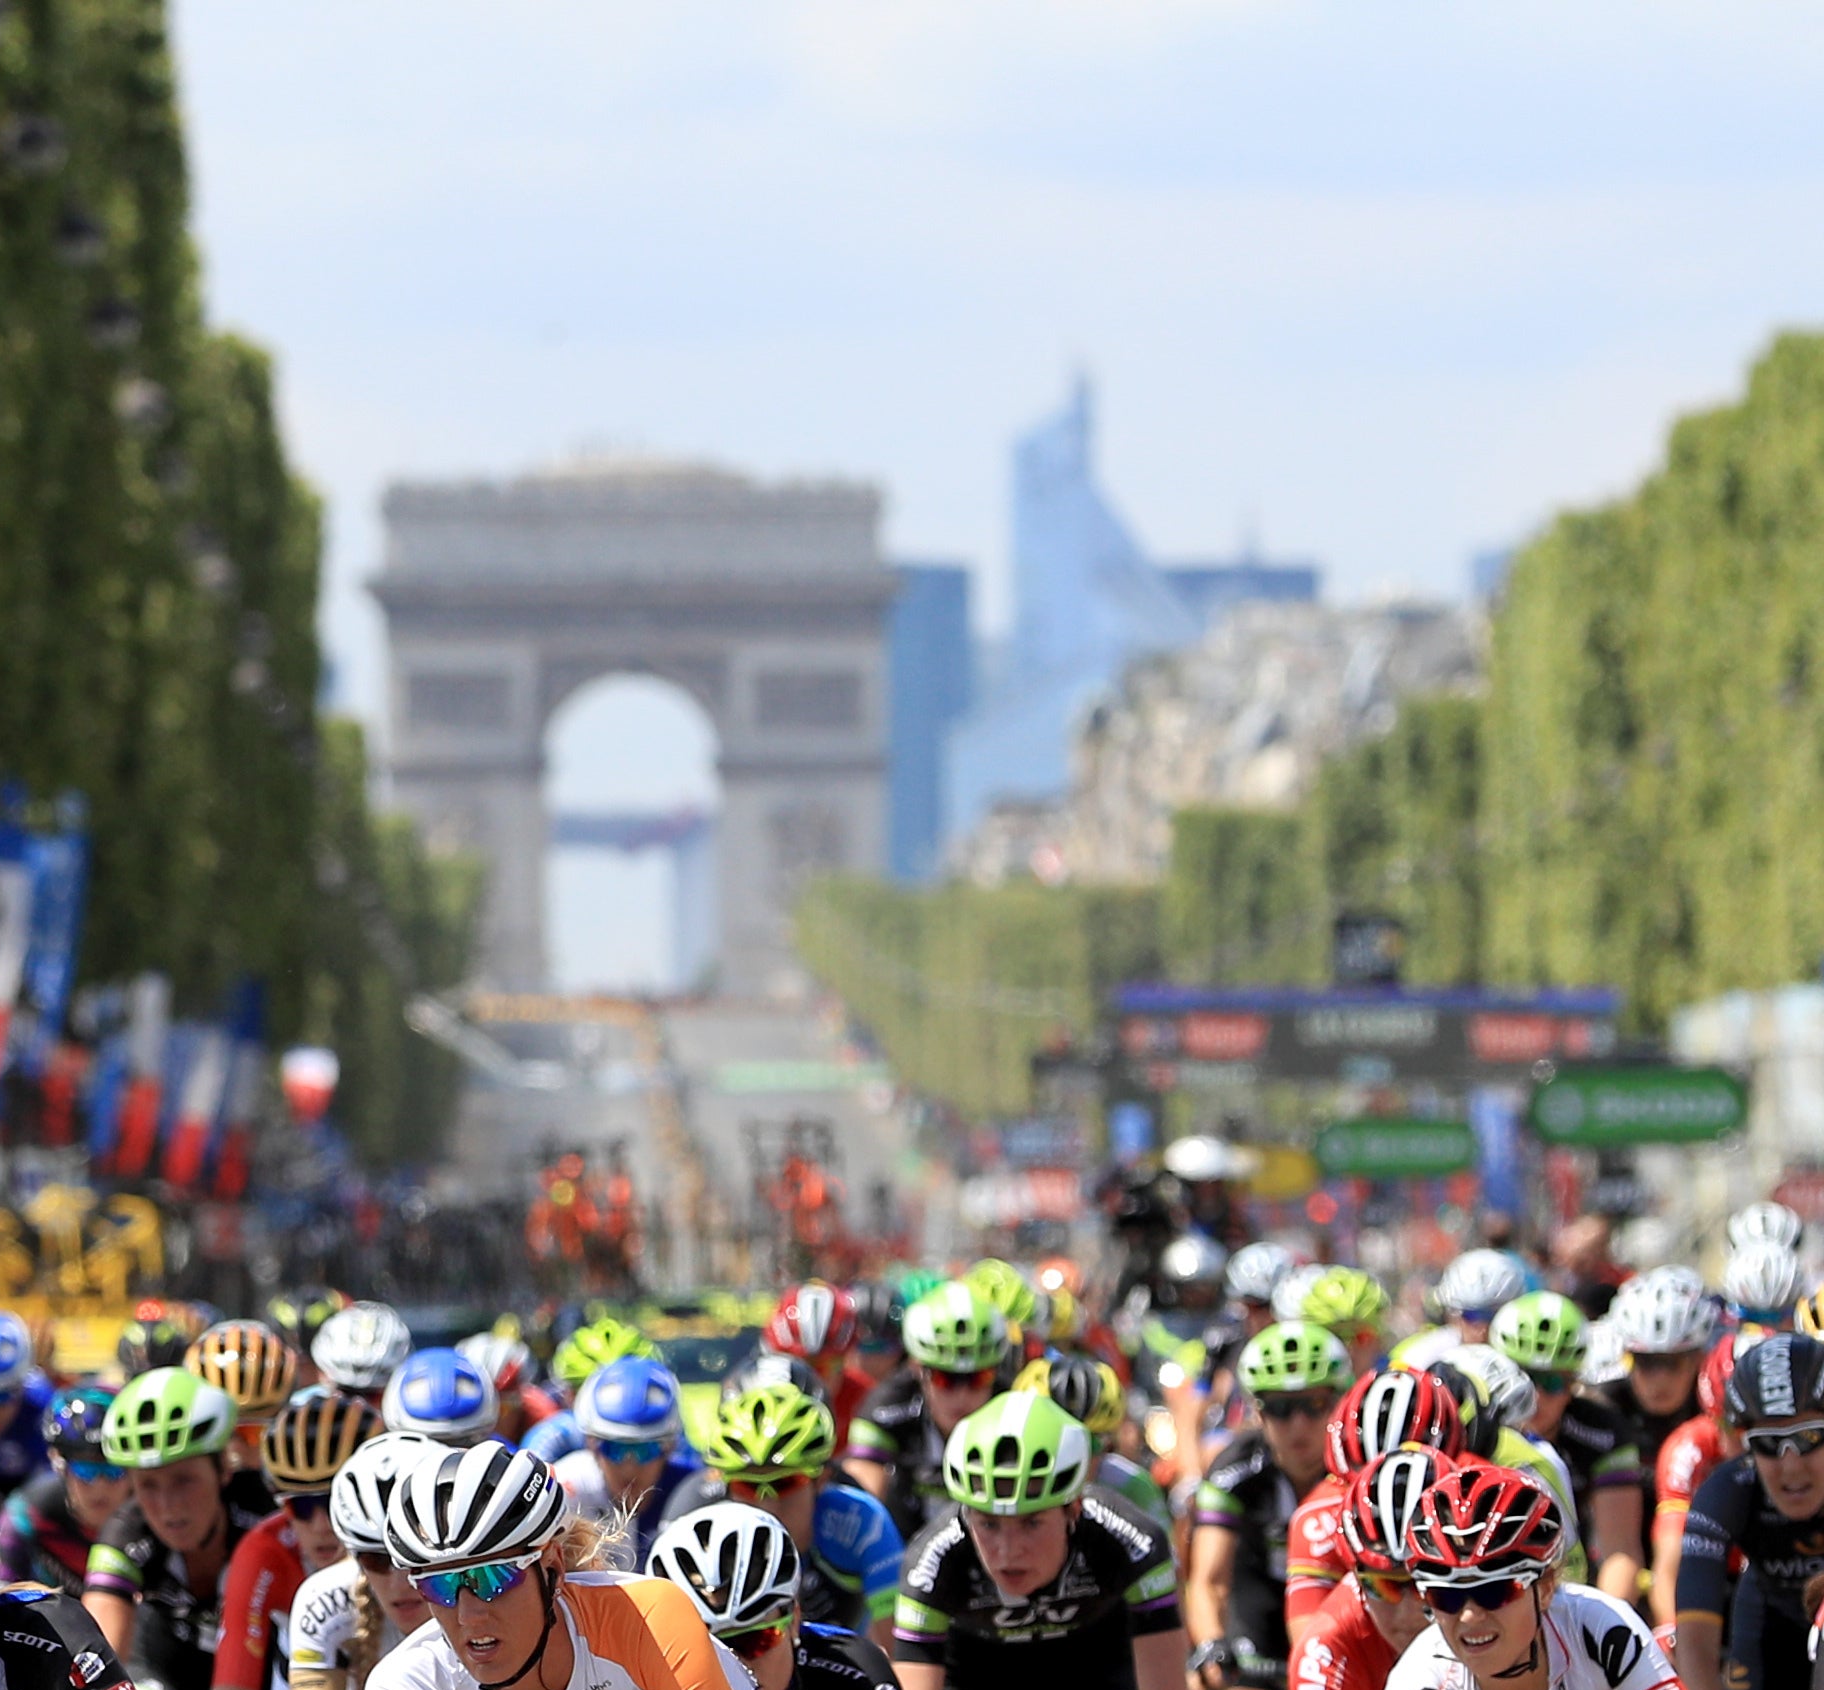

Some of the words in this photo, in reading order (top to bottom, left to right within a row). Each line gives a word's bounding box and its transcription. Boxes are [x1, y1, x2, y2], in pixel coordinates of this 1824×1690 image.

[524, 1472, 544, 1503] GIRO
[3, 1630, 63, 1653] SCOTT
[810, 1657, 868, 1680] SCOTT
